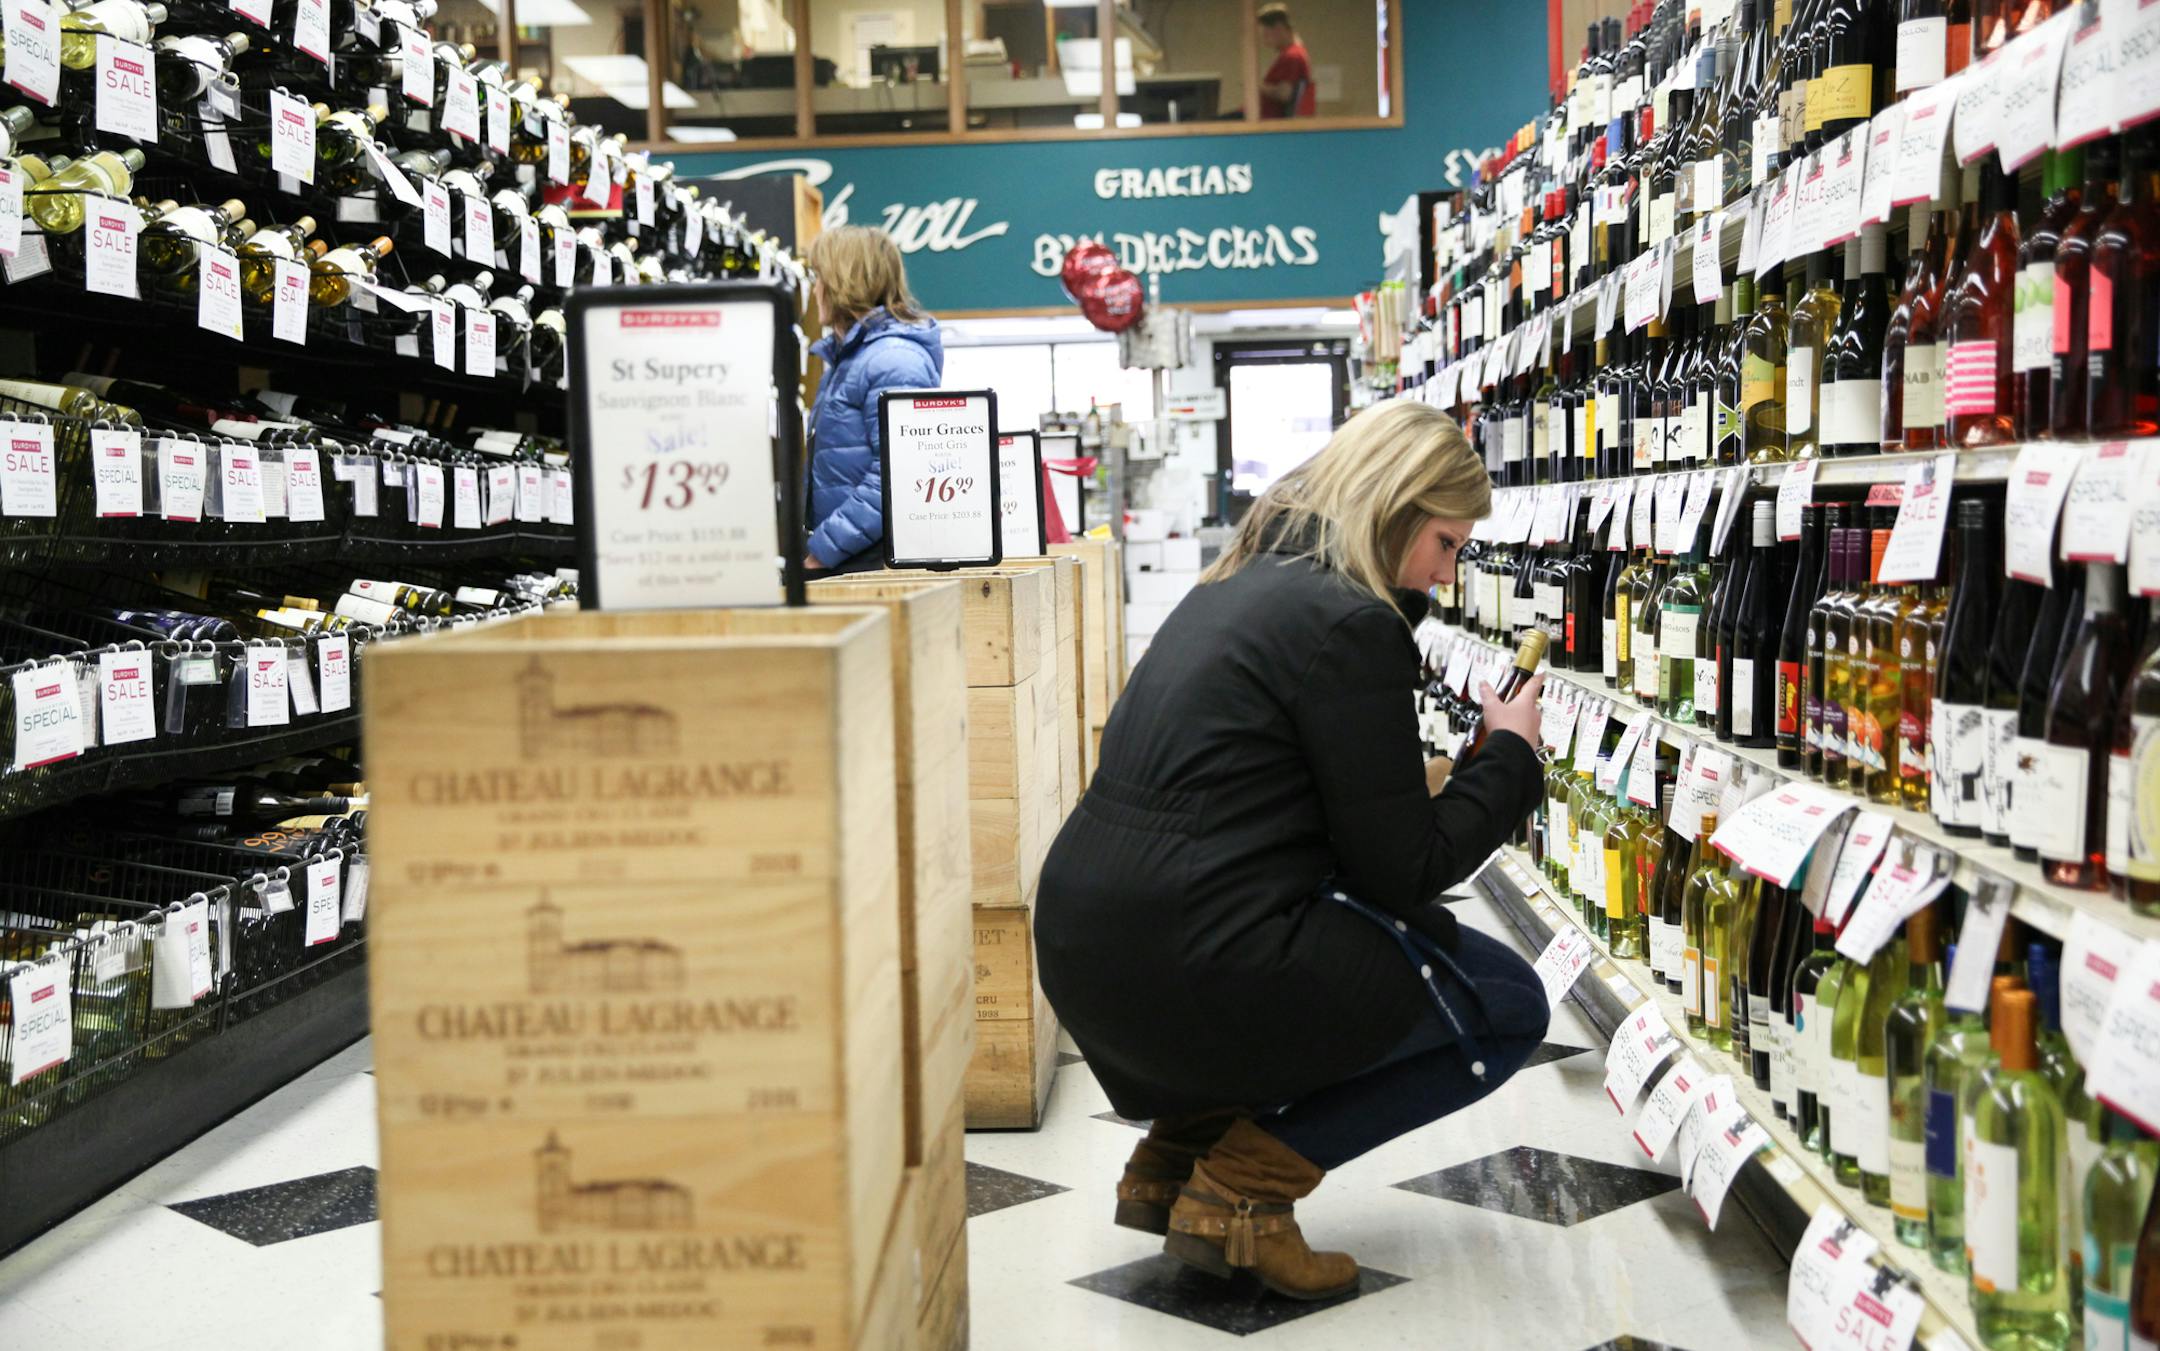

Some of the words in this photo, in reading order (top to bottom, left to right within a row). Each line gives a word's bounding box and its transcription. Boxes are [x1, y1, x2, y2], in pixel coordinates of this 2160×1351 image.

[10, 29, 56, 67] SPECIAL
[106, 70, 151, 98] SALE
[277, 120, 311, 146] SALE
[1094, 164, 1252, 199] GRACIAS
[1825, 177, 1858, 205] SPECIAL
[1797, 181, 1826, 210] SALE
[881, 197, 1009, 254] you
[93, 229, 132, 254] SALE
[206, 273, 237, 299] SALE
[622, 313, 720, 326] SURDYK'S
[612, 359, 635, 382] St
[644, 356, 730, 384] Supery
[596, 391, 692, 411] Sauvignon
[697, 389, 748, 408] Blanc
[914, 400, 966, 408] SURDYK'S
[646, 420, 710, 454] Sale!
[900, 424, 932, 437] Four
[936, 423, 984, 436] Graces
[917, 440, 943, 451] Pinot
[946, 439, 968, 450] Gris
[6, 453, 49, 473] SALE
[928, 457, 962, 474] Sale!
[99, 469, 138, 484] SPECIAL
[165, 474, 201, 491] SPECIAL
[228, 471, 258, 486] SALE
[290, 473, 317, 487] SALE
[908, 512, 928, 521] Case
[1901, 497, 1938, 527] SALE
[254, 673, 284, 688] SALE
[324, 661, 347, 677] SALE
[108, 681, 147, 701] SALE
[23, 706, 77, 732] SPECIAL
[408, 765, 578, 805] CHATEAU
[591, 759, 795, 800] LAGRANGE
[976, 996, 997, 1004] CRU
[20, 1009, 67, 1041] SPECIAL
[416, 1002, 588, 1040] CHATEAU
[600, 995, 798, 1036] LAGRANGE
[426, 1243, 597, 1278] CHATEAU
[607, 1233, 807, 1272] LAGRANGE
